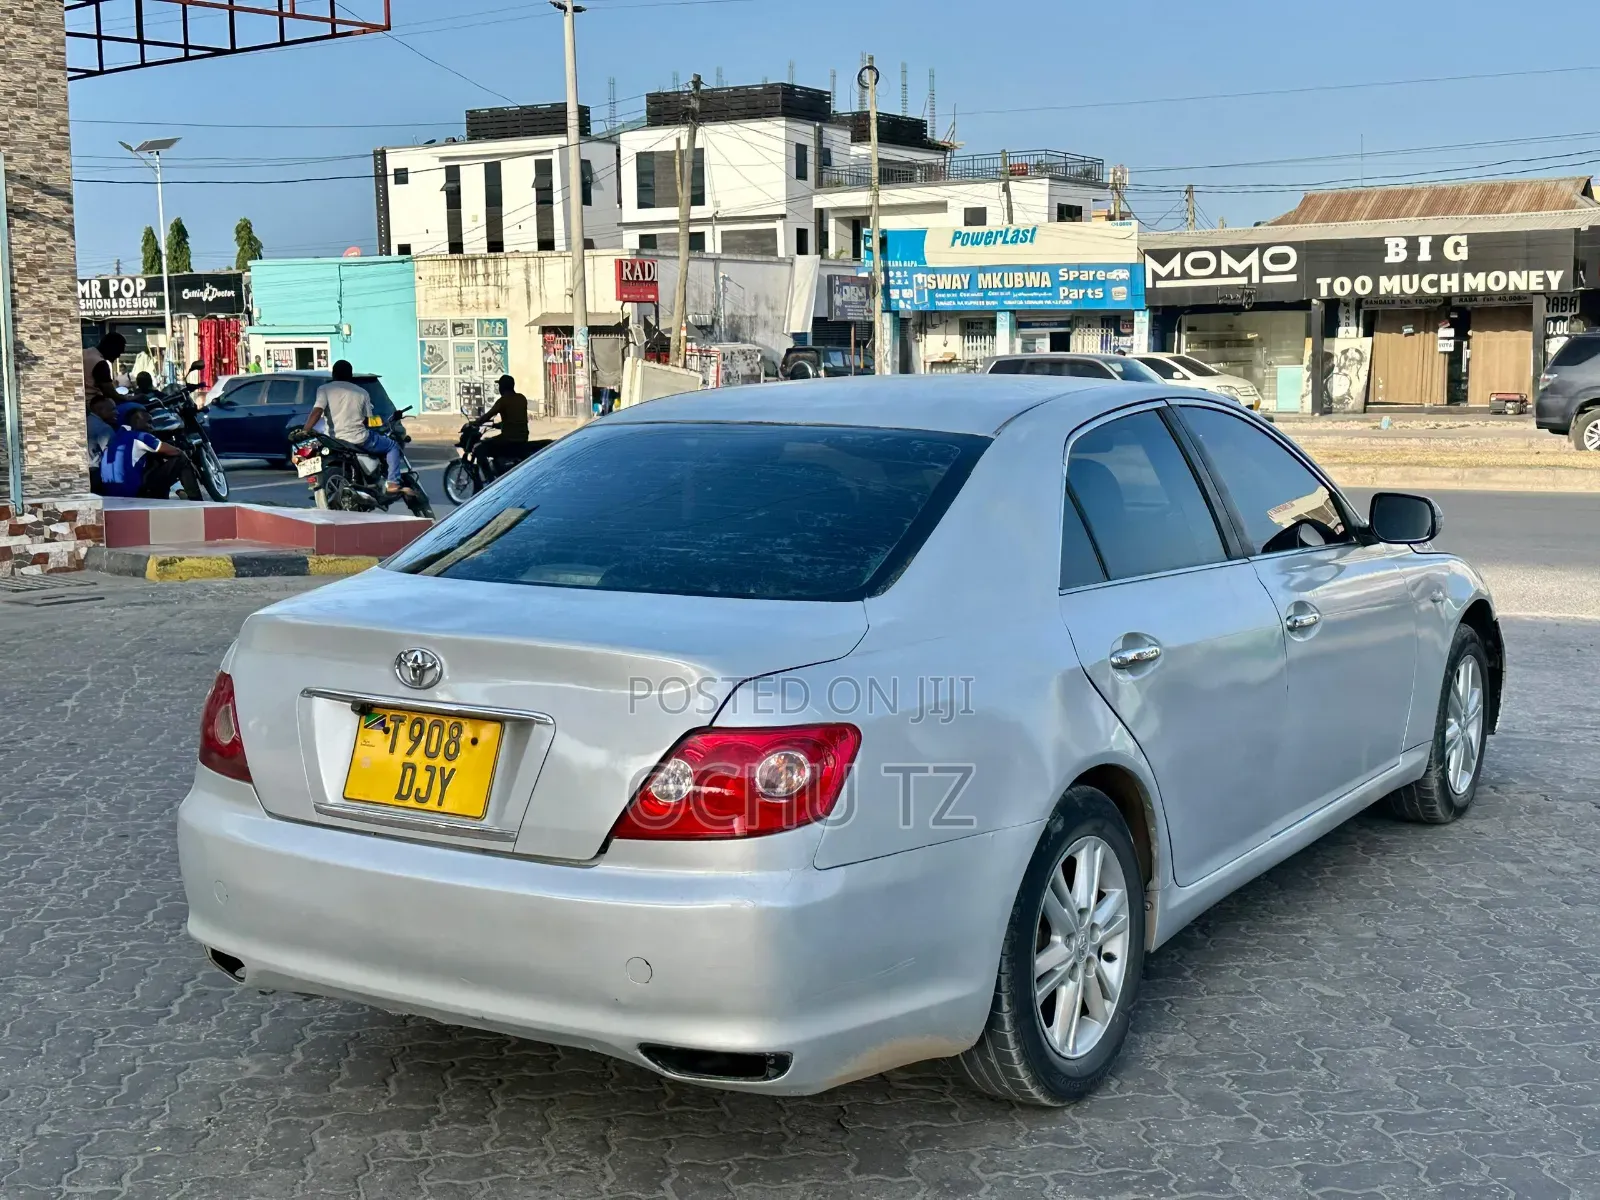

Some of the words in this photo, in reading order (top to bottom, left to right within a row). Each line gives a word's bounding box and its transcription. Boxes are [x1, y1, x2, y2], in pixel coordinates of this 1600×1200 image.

[950, 226, 1038, 248] PowerLast
[1384, 235, 1469, 263] BIG
[927, 273, 970, 290] SWAY
[978, 272, 1052, 289] MKUBWA
[1058, 268, 1106, 282] Spare
[1145, 246, 1298, 288] MOMO
[77, 278, 102, 298] MR
[109, 278, 147, 298] POP
[182, 285, 211, 301] Cutting
[208, 284, 236, 301] Doctor
[1059, 286, 1104, 300] Parts
[1316, 275, 1373, 297] TOO
[1379, 272, 1460, 296] MUCH
[1463, 270, 1565, 293] MONEY
[388, 714, 464, 761] T908
[394, 762, 457, 807] DJY
